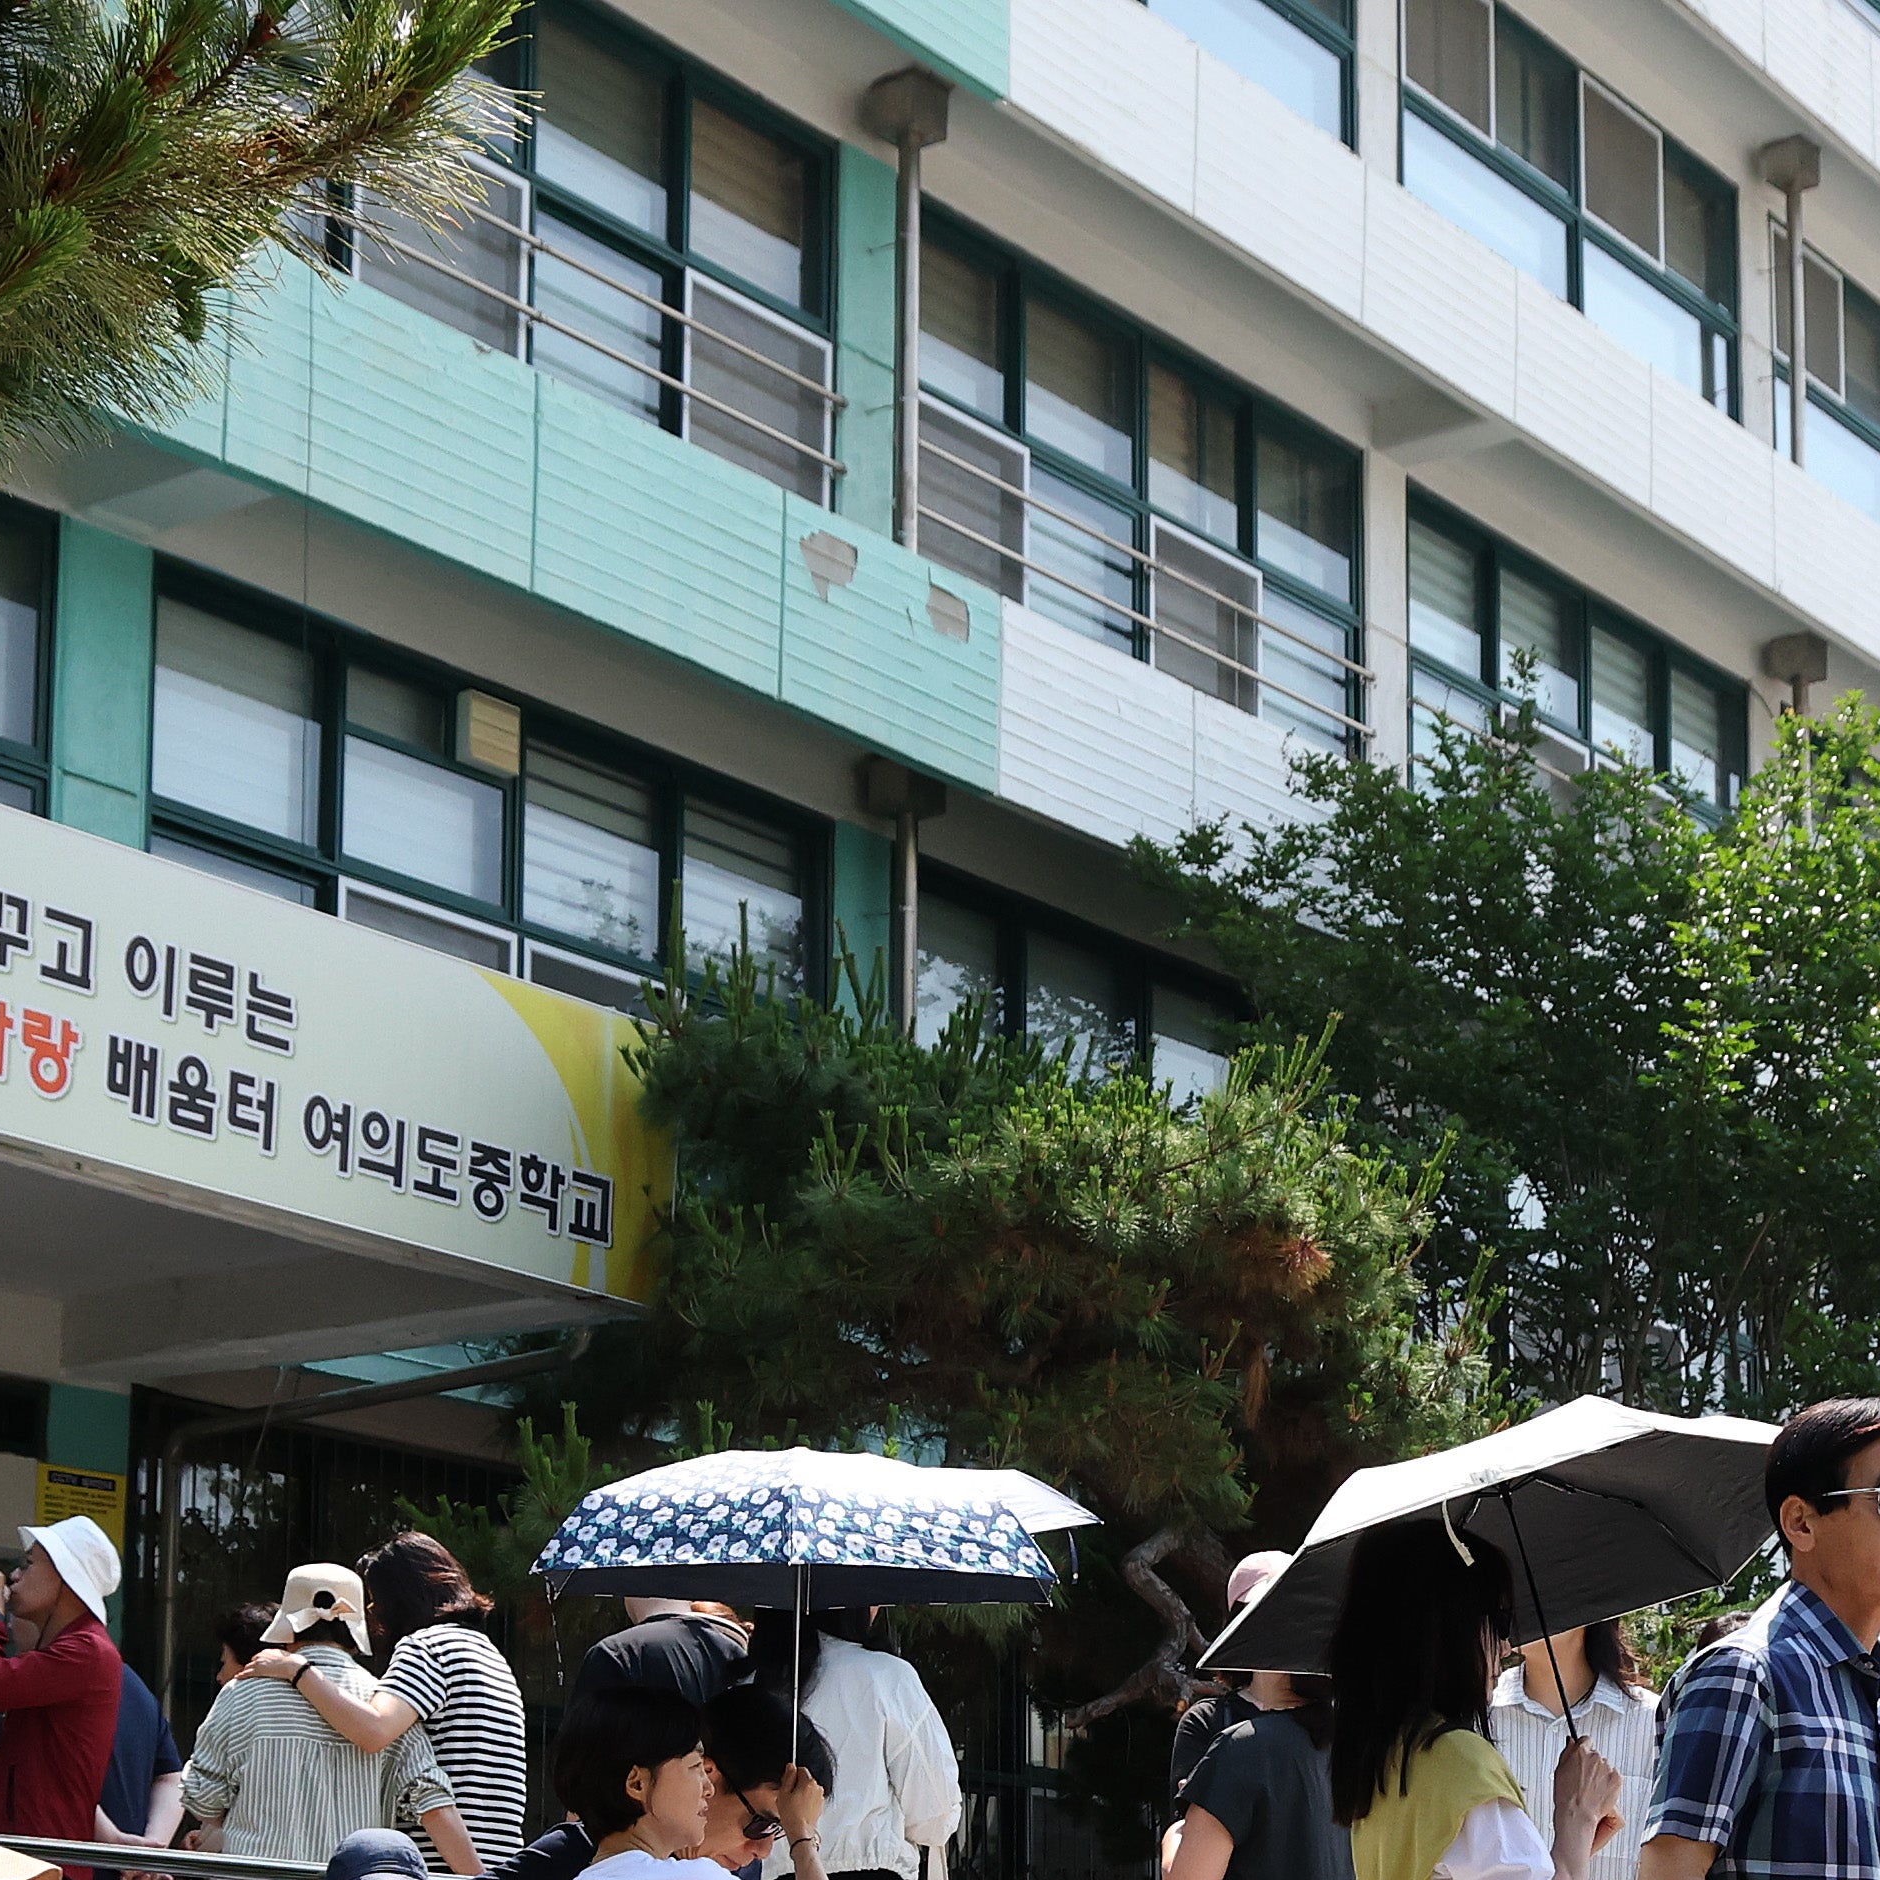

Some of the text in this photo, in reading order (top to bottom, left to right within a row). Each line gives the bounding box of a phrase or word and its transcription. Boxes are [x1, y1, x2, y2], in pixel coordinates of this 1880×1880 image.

[124, 934, 297, 1055] 이루는
[107, 1034, 276, 1154] 배움터
[304, 1094, 614, 1246] 여의도중학교
